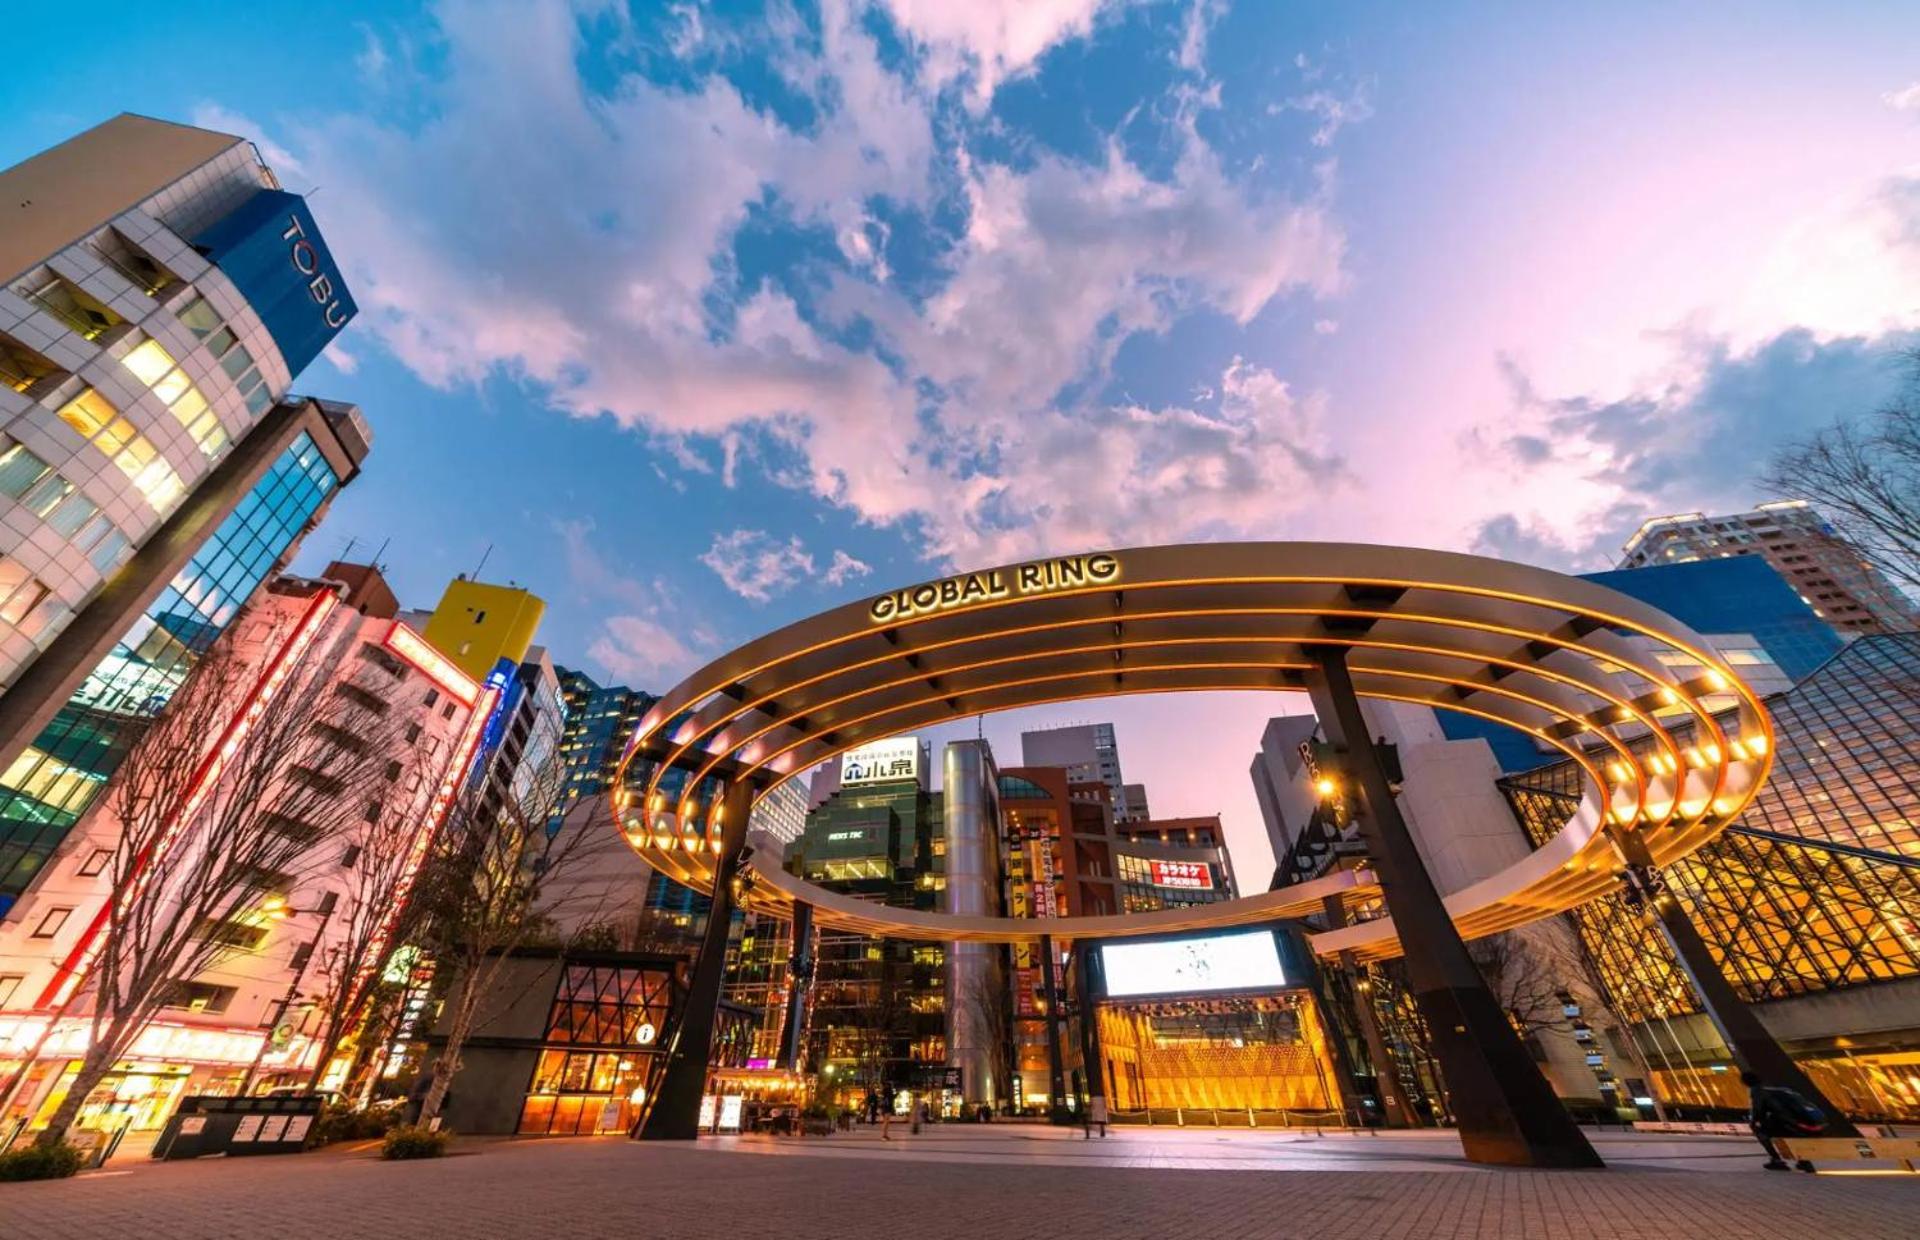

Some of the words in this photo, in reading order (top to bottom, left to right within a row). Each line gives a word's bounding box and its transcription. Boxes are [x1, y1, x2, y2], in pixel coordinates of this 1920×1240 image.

[279, 214, 348, 330] TOBU
[870, 570, 1007, 619] GLOBAL
[1020, 555, 1118, 589] RING
[863, 758, 913, 779] 小泉
[1158, 863, 1200, 876] カラオケ
